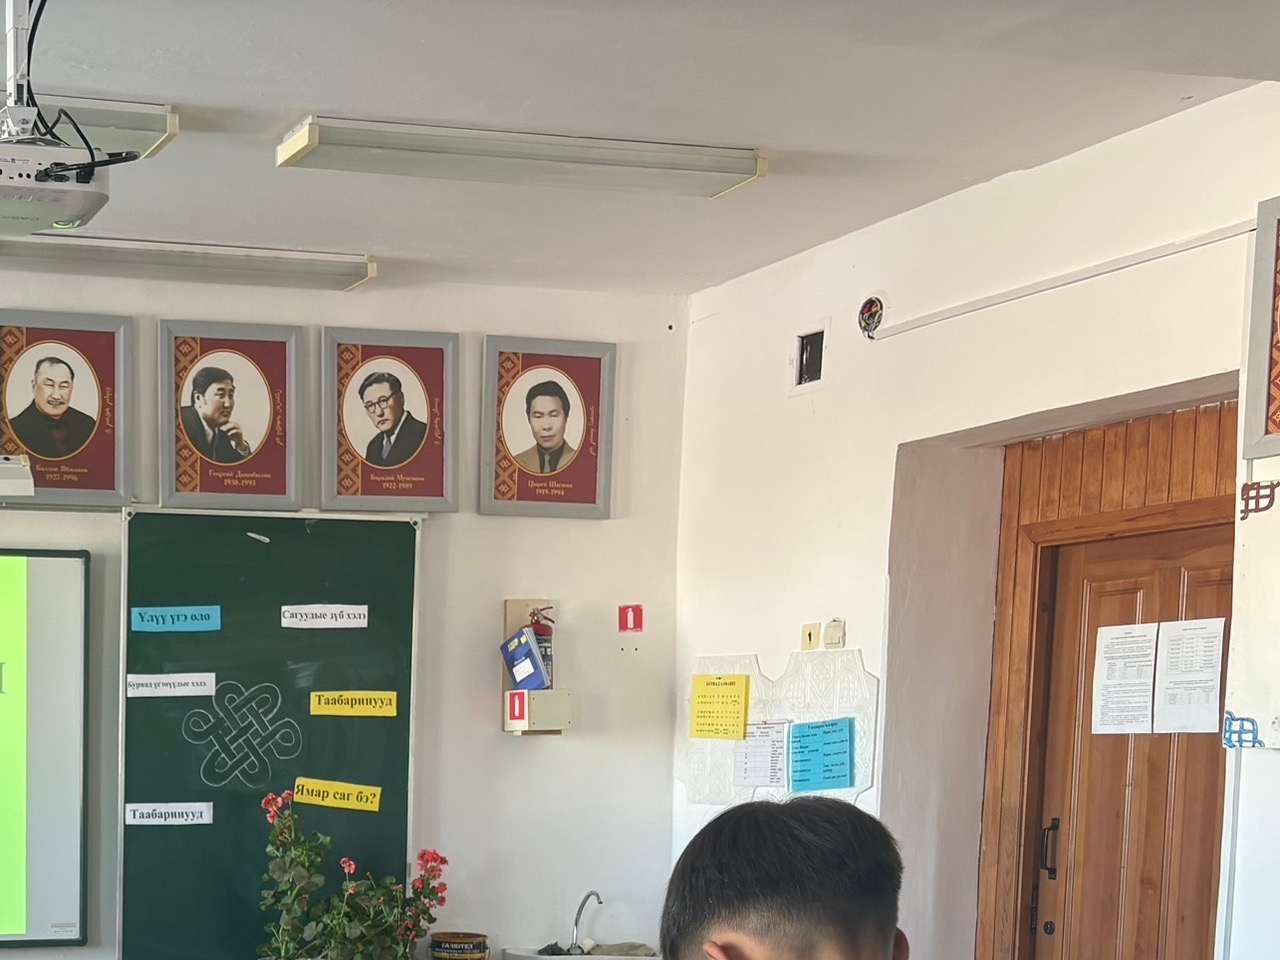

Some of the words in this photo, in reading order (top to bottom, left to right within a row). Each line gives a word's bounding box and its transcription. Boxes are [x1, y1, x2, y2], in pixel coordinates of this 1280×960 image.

[190, 613, 211, 621] оло
[295, 784, 329, 801] Ямар
[333, 791, 353, 801] саг
